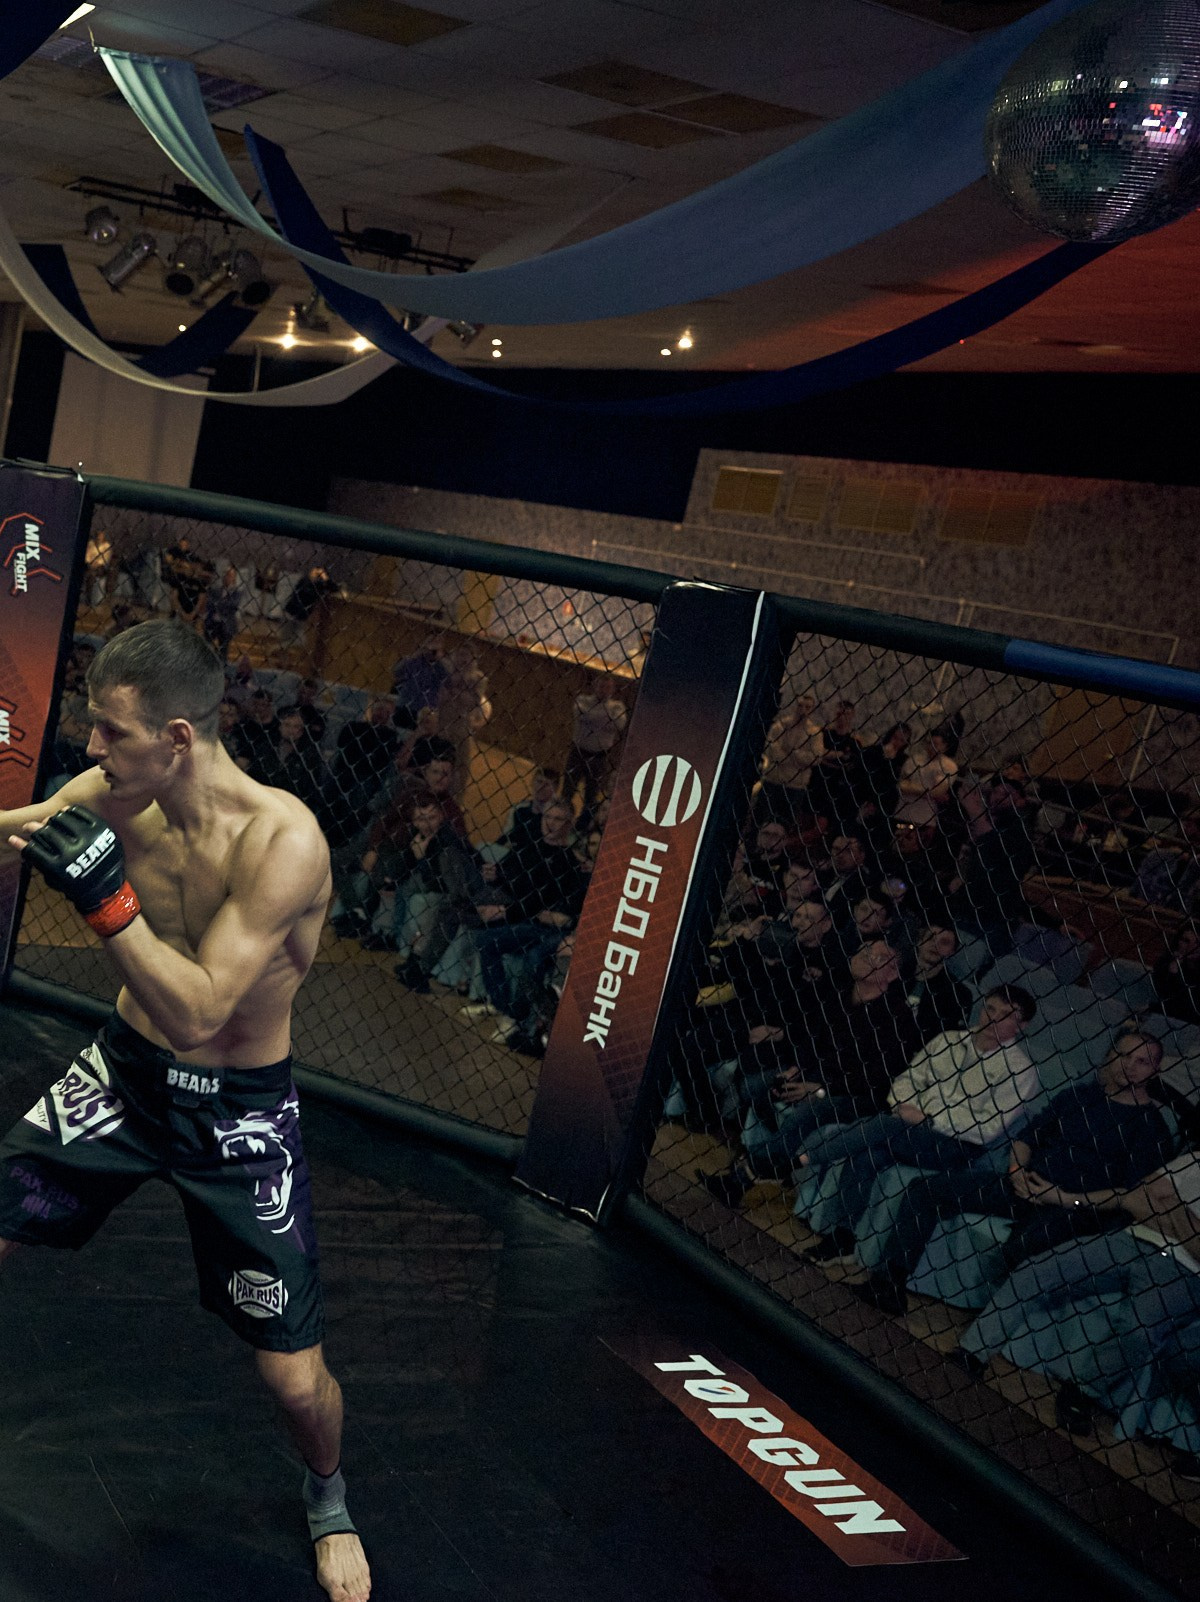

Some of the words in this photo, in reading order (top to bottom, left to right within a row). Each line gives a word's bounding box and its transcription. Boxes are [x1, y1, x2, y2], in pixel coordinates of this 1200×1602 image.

[25, 523, 40, 561] MIX
[16, 552, 28, 592] FIGHT
[65, 828, 117, 879] BEARS
[612, 835, 669, 939] НБД
[583, 941, 640, 1049] Банк
[60, 1072, 117, 1127] RUS
[167, 1068, 220, 1094] BEARS
[236, 1277, 254, 1300] PAK
[257, 1286, 280, 1309] RUS
[654, 1355, 907, 1534] TOPGUN
